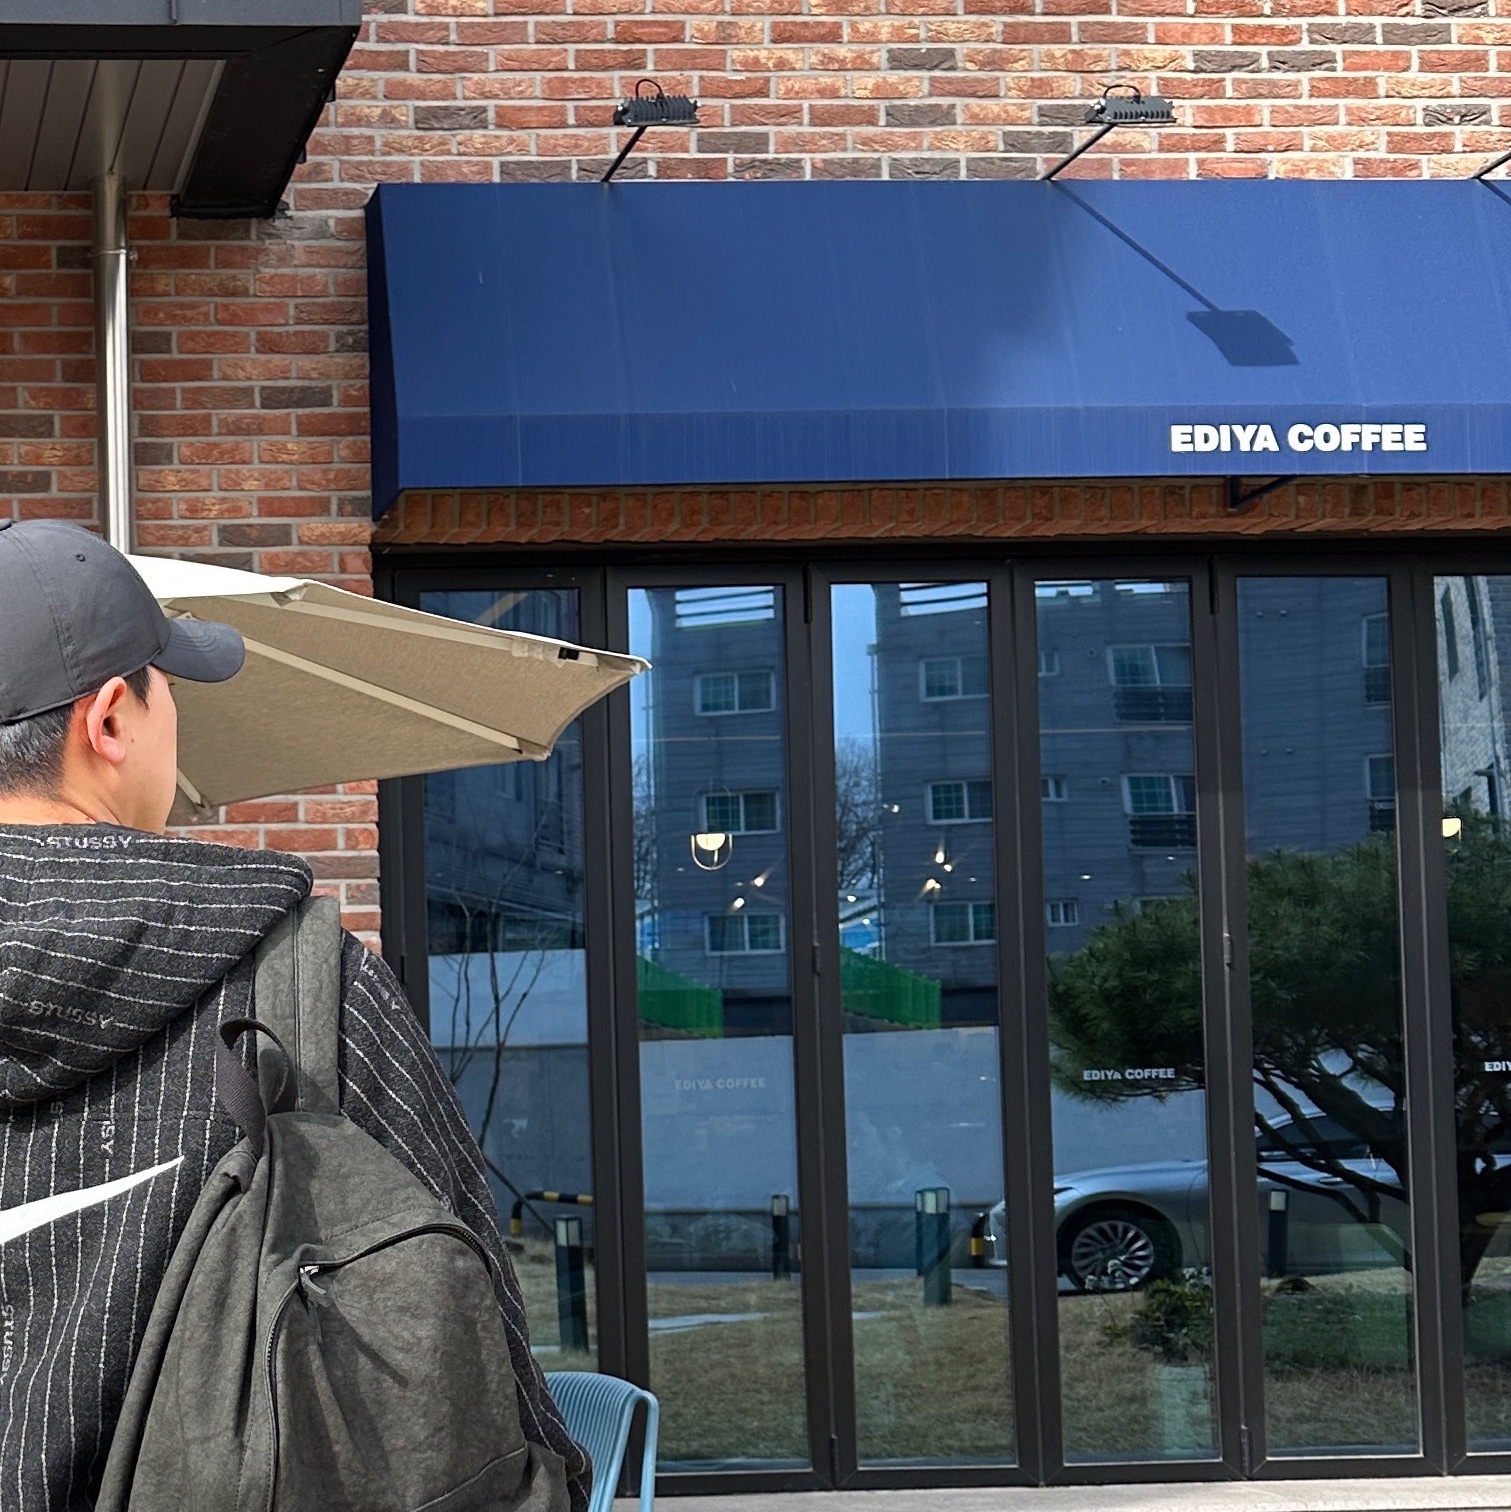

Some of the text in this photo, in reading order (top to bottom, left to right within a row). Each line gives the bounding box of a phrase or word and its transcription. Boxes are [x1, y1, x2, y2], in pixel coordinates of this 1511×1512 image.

[1170, 423, 1428, 452] EDIYA COFFEE
[46, 835, 133, 850] STUSSY
[28, 1000, 114, 1029] STUSSY
[674, 1077, 767, 1091] EDIYA COFFEE
[1083, 1067, 1176, 1081] EDIYA COFFEE
[0, 1304, 14, 1386] STUSSY
